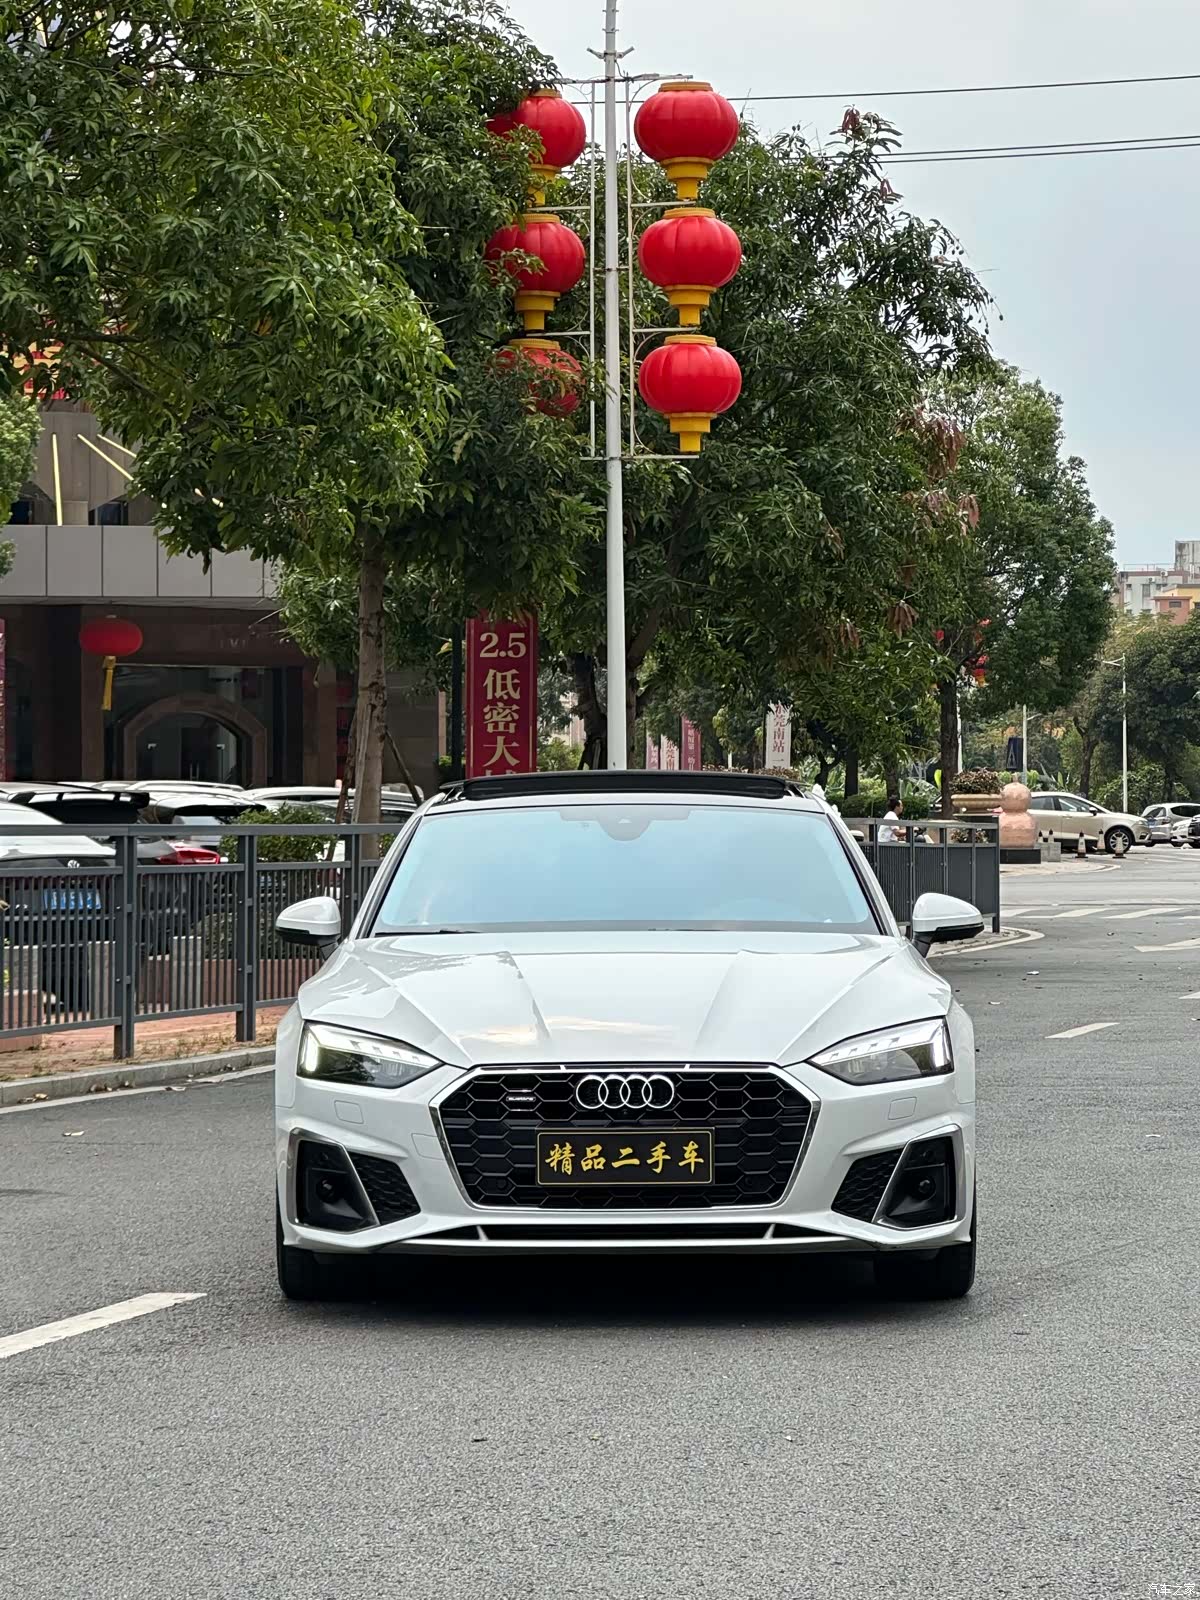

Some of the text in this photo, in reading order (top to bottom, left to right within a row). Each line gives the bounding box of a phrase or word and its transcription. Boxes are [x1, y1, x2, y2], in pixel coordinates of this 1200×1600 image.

[482, 668, 521, 777] 低密大
[545, 1140, 704, 1175] 精品二手车
